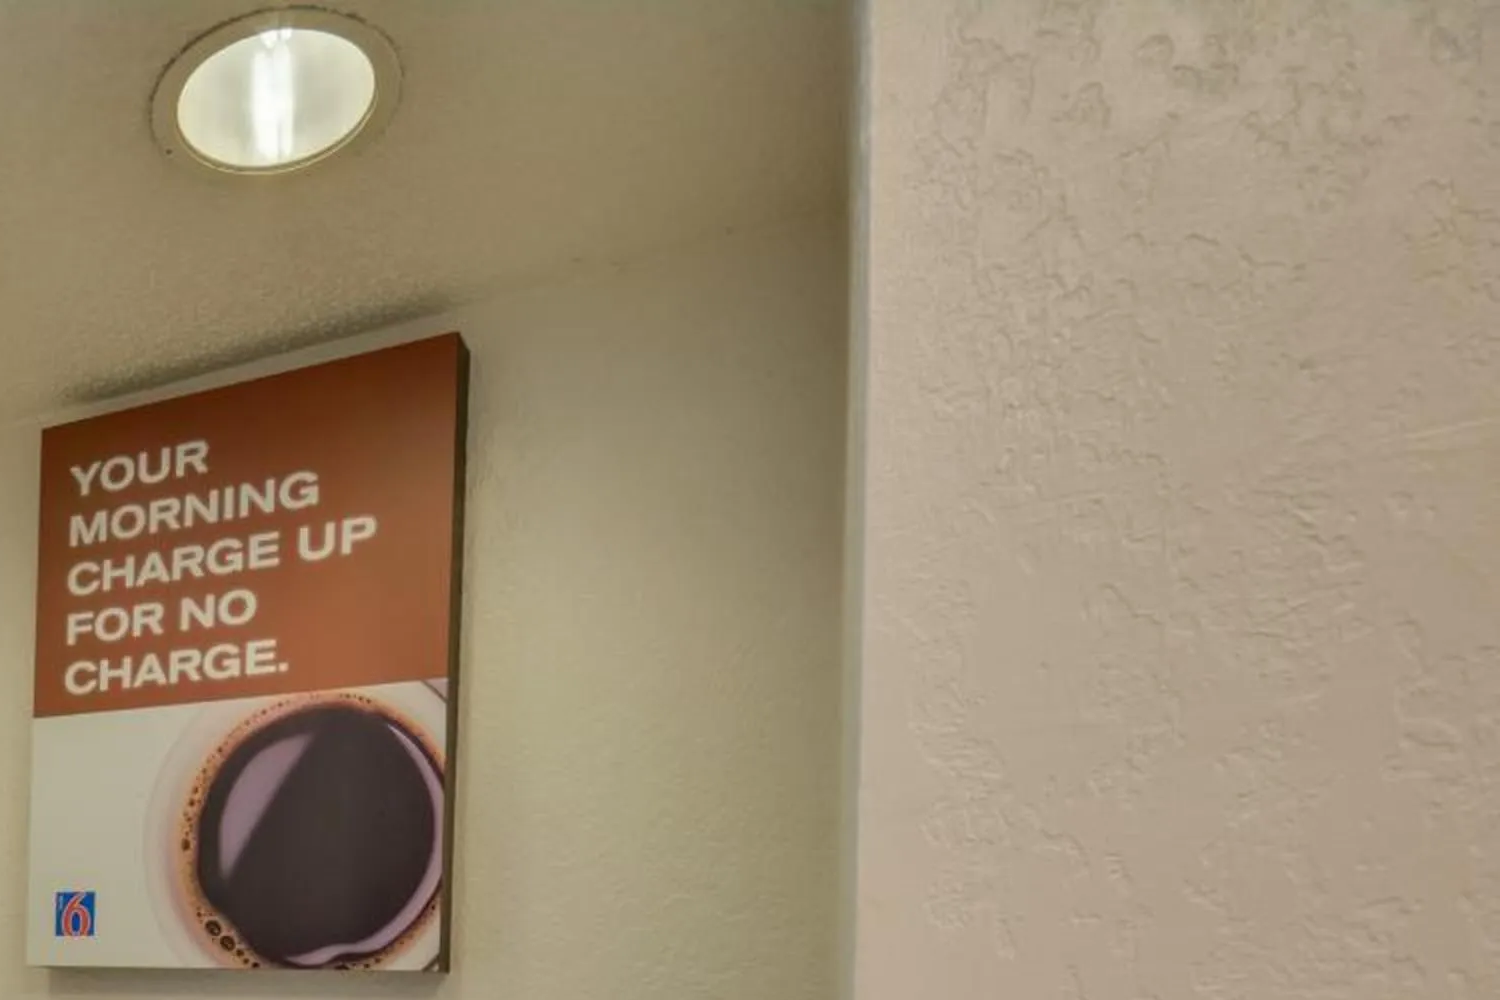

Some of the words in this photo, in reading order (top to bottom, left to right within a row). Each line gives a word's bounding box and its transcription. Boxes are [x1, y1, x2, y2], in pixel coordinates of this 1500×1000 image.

[71, 440, 209, 496] YOUR
[69, 471, 320, 547] MORNING
[67, 531, 280, 596] CHARGE
[297, 515, 378, 562] UP
[66, 602, 165, 646] FOR
[179, 588, 258, 632] NO
[64, 638, 289, 695] CHARGE.
[61, 890, 92, 938] 6
